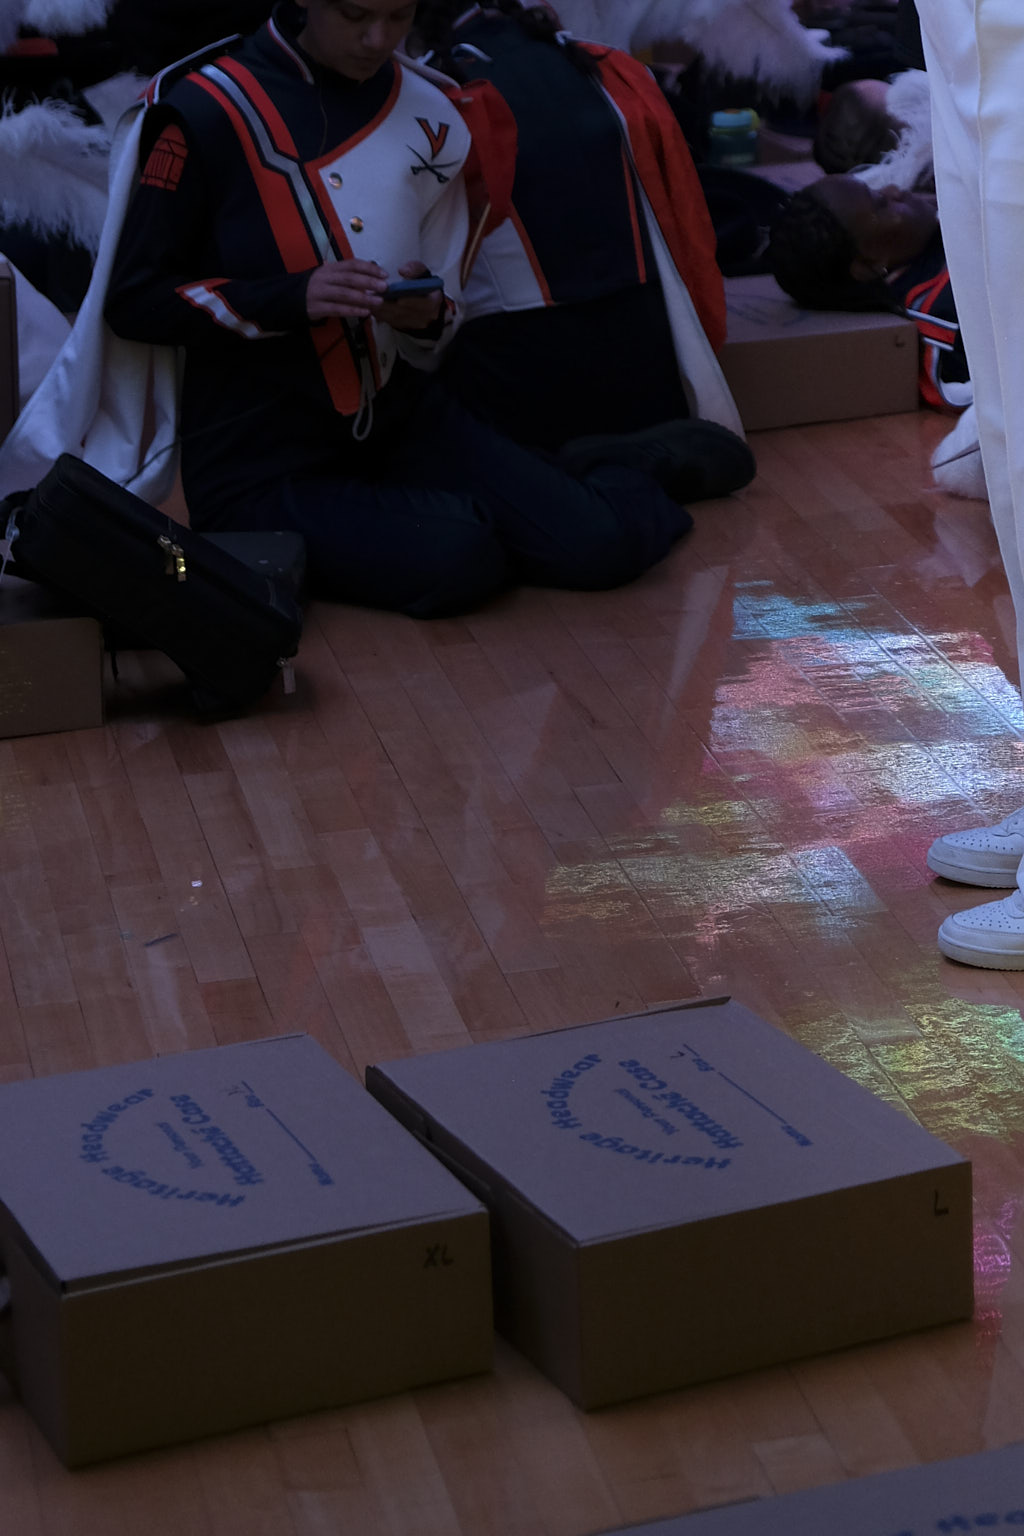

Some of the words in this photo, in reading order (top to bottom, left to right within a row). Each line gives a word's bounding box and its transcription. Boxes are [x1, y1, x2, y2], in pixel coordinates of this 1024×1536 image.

[540, 1053, 602, 1130] Headwear
[618, 1059, 668, 1091] Case
[79, 1088, 155, 1163] Headwear
[169, 1094, 211, 1125] Case
[579, 1132, 733, 1169] Heritage
[101, 1165, 246, 1207] Heritage
[934, 1188, 949, 1217] L
[423, 1242, 454, 1268] XL
